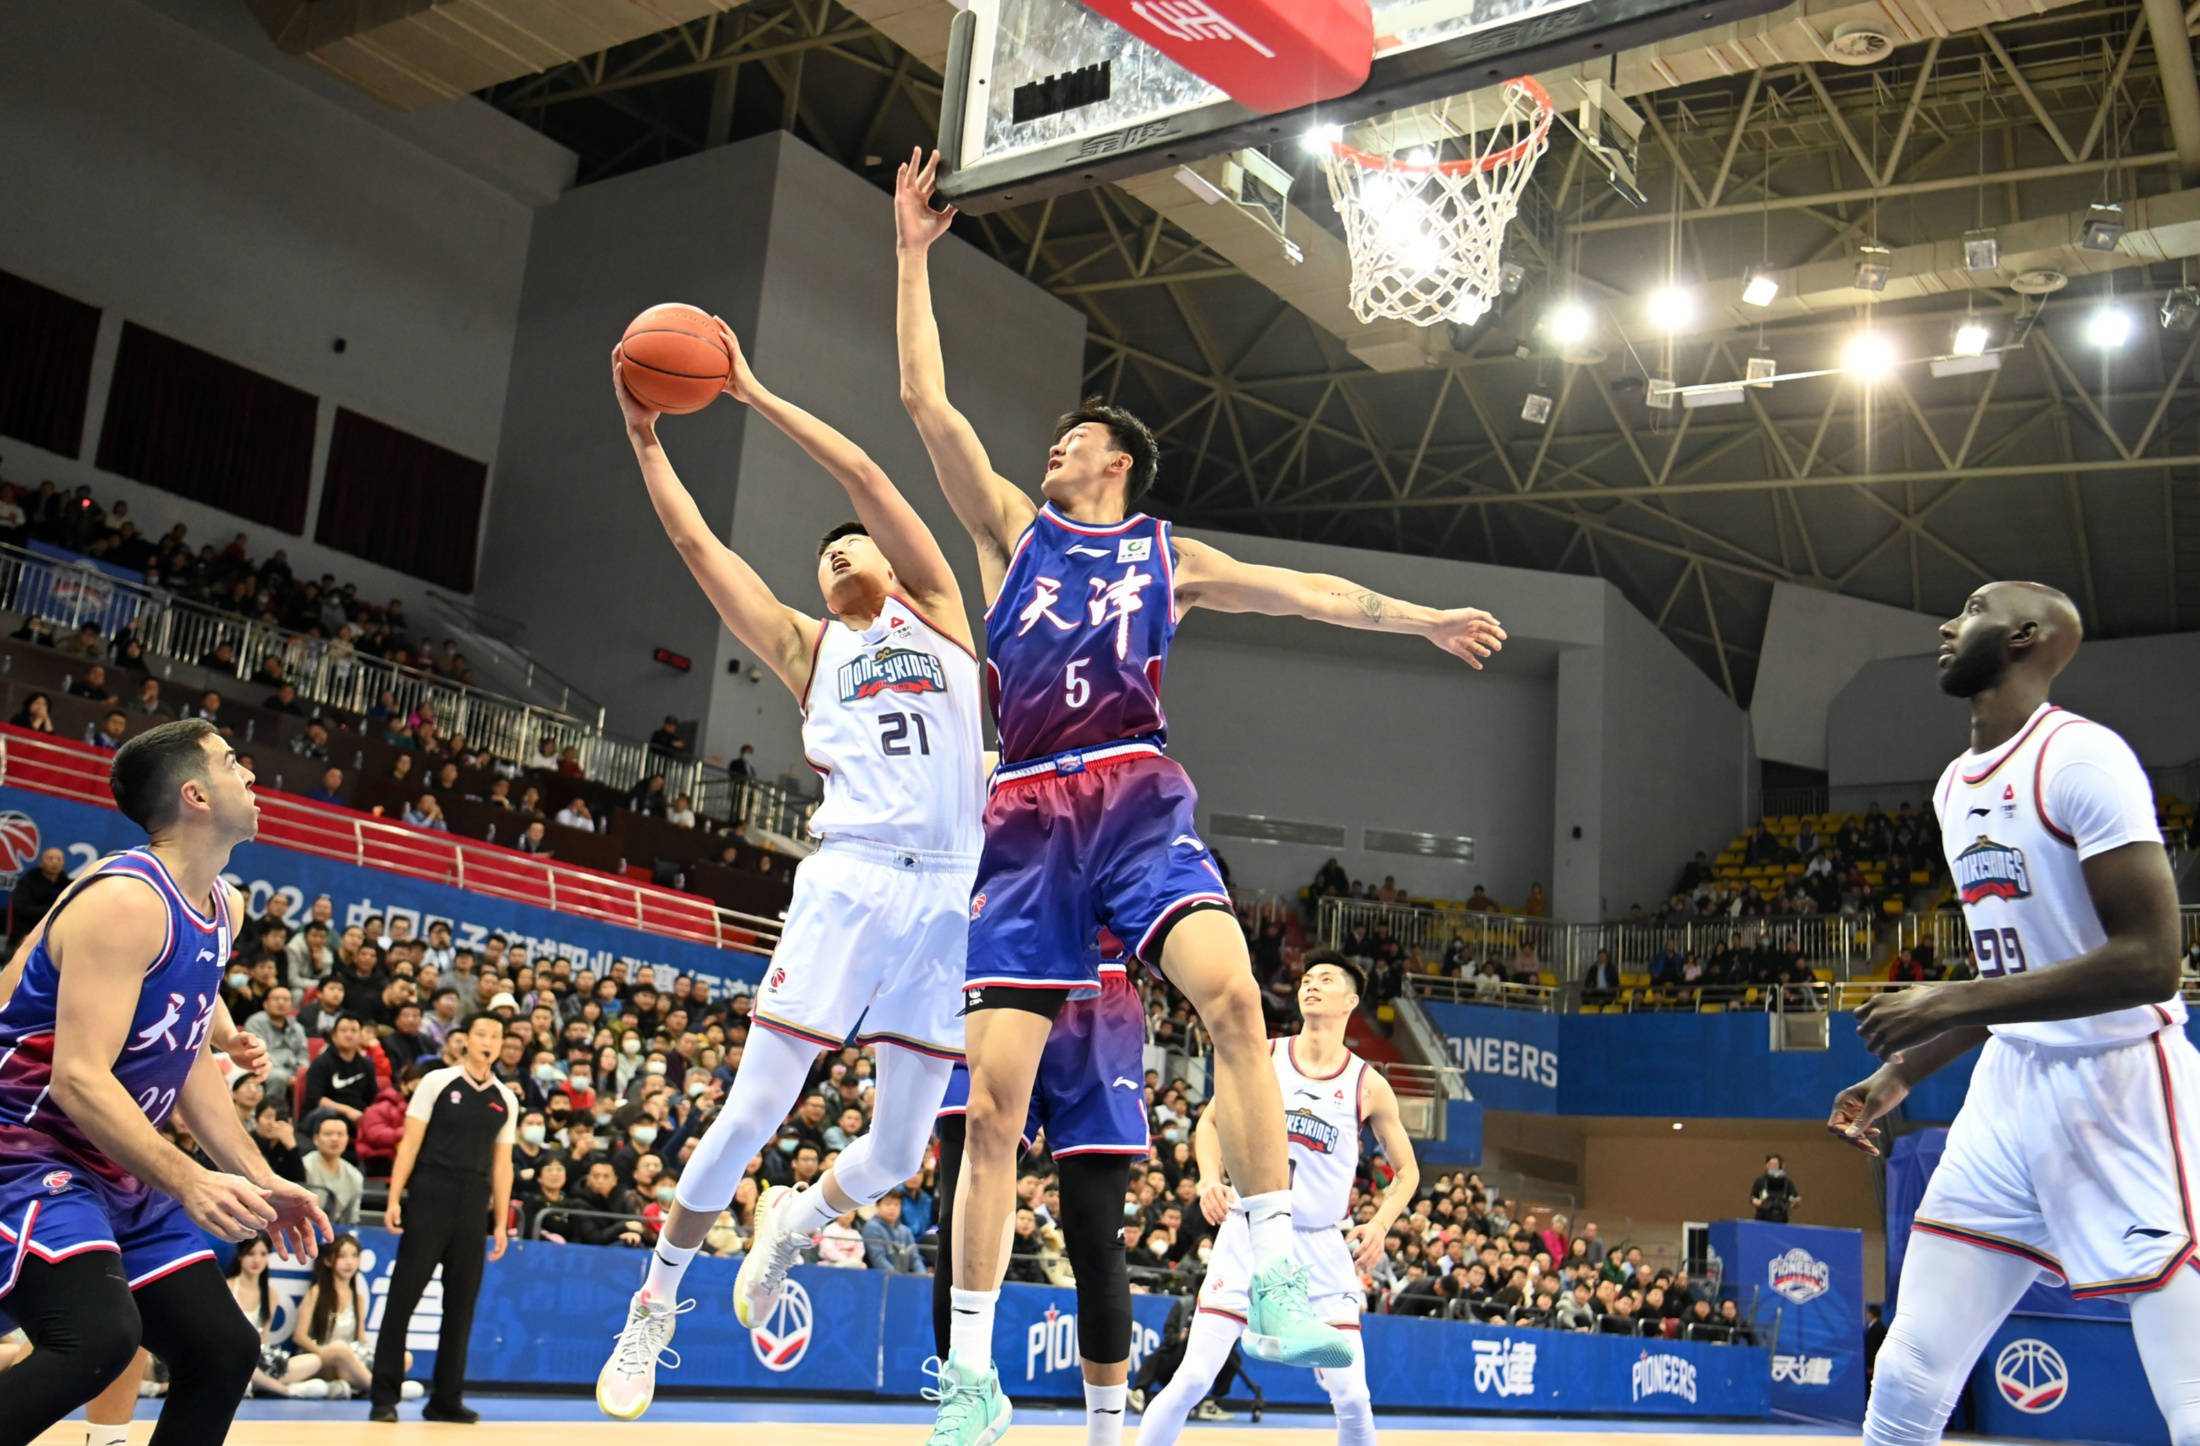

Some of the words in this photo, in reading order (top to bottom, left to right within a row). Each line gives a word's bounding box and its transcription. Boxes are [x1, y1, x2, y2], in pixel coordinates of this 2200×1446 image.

[1017, 564, 1152, 661] 天津
[1065, 657, 1091, 708] 5
[878, 712, 930, 756] 21
[1973, 927, 2027, 978] 99
[1447, 1036, 1558, 1088] ONEERS
[1286, 1113, 1338, 1153] KEYKINGS
[1632, 1353, 1697, 1404] PIONEERS
